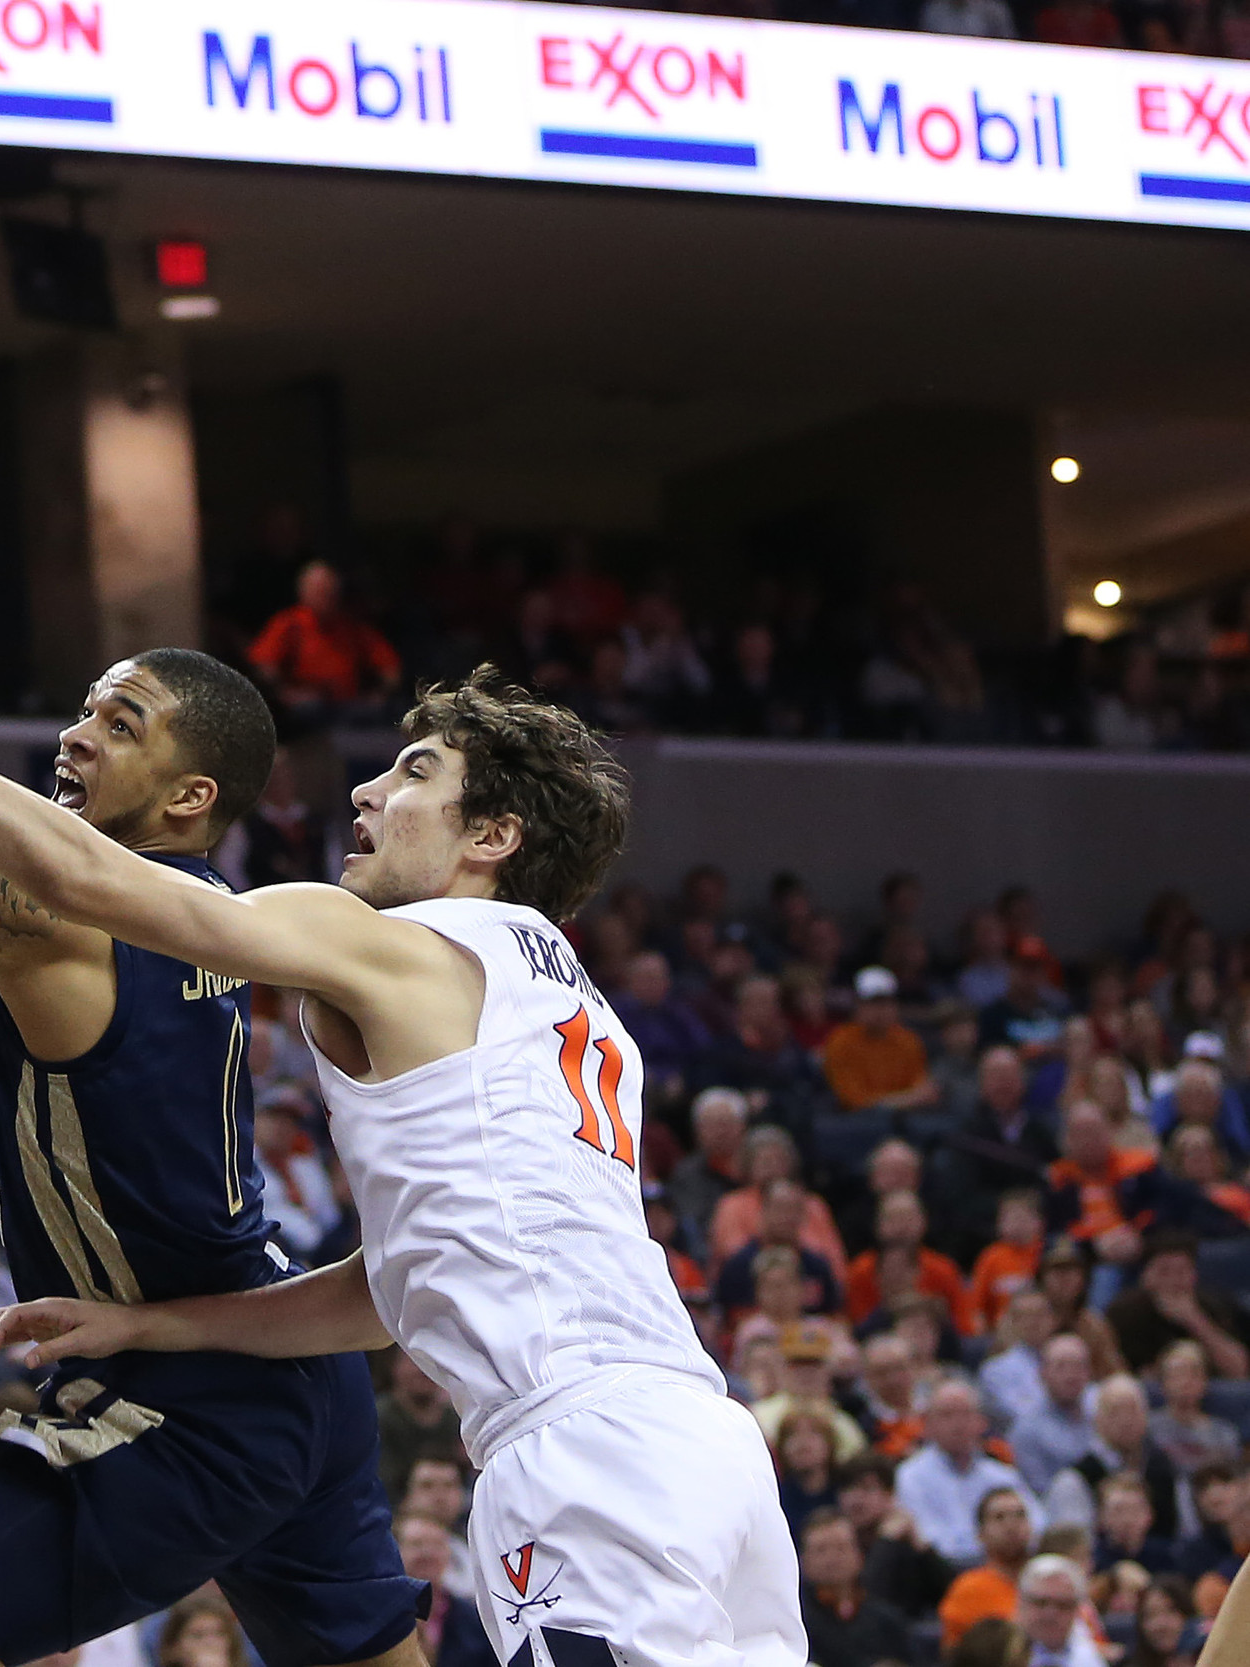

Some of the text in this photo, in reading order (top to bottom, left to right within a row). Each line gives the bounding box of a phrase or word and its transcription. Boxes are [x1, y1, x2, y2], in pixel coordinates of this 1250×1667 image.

[203, 31, 451, 122] Mobil
[539, 33, 745, 119] EXXON
[837, 79, 1067, 168] Mobil
[1137, 82, 1250, 163] EXX
[552, 1001, 635, 1173] 11
